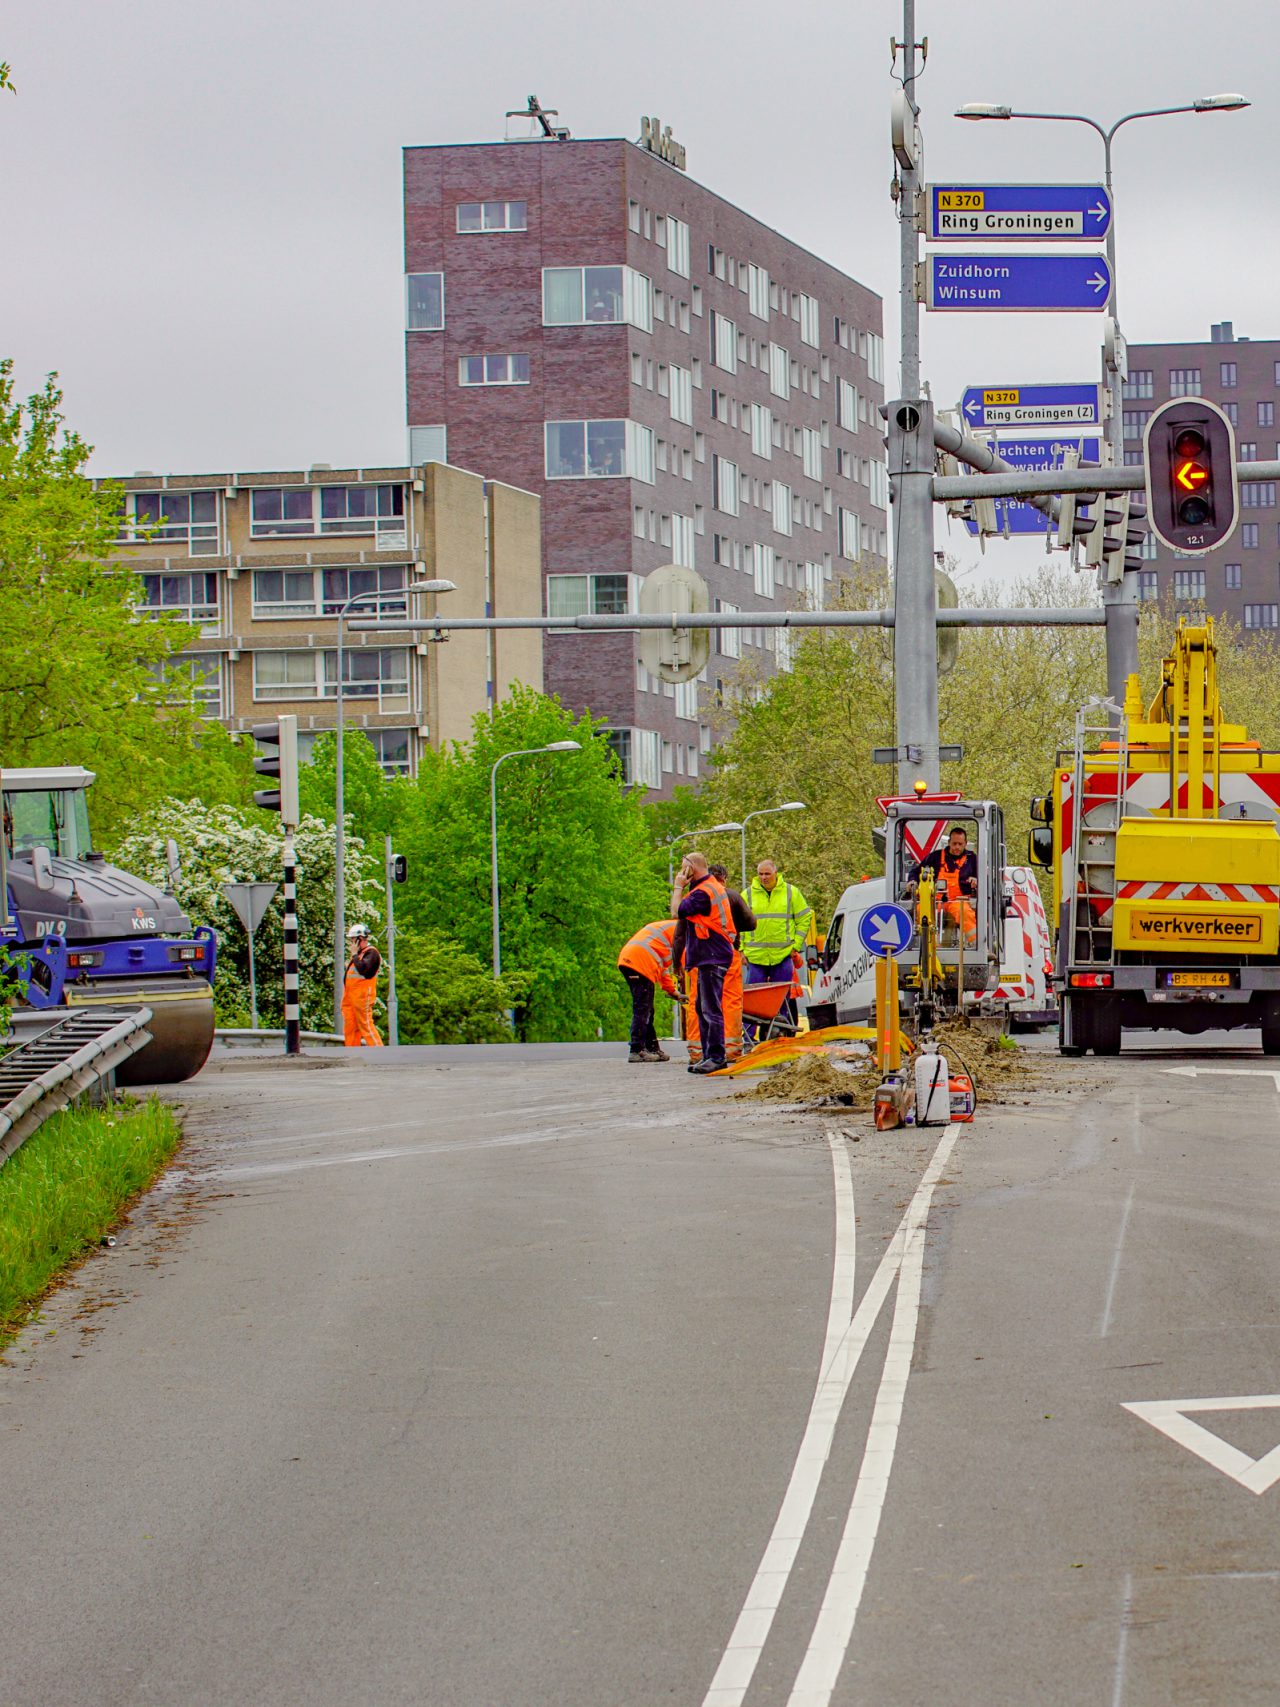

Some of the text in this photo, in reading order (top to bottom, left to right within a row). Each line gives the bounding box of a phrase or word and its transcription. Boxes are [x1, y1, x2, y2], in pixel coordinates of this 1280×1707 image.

[942, 195, 981, 206] N 370
[942, 214, 1074, 231] Ring Groningen
[938, 264, 1010, 278] Zuidhorn
[938, 286, 1001, 299] Winsum
[986, 392, 1017, 402] N 370
[986, 406, 1093, 421] Ring Groningen (Z)
[1186, 535, 1204, 545] 12.1
[35, 920, 67, 937] DV 9
[131, 917, 157, 930] KWS
[1139, 917, 1254, 935] werkverkeer
